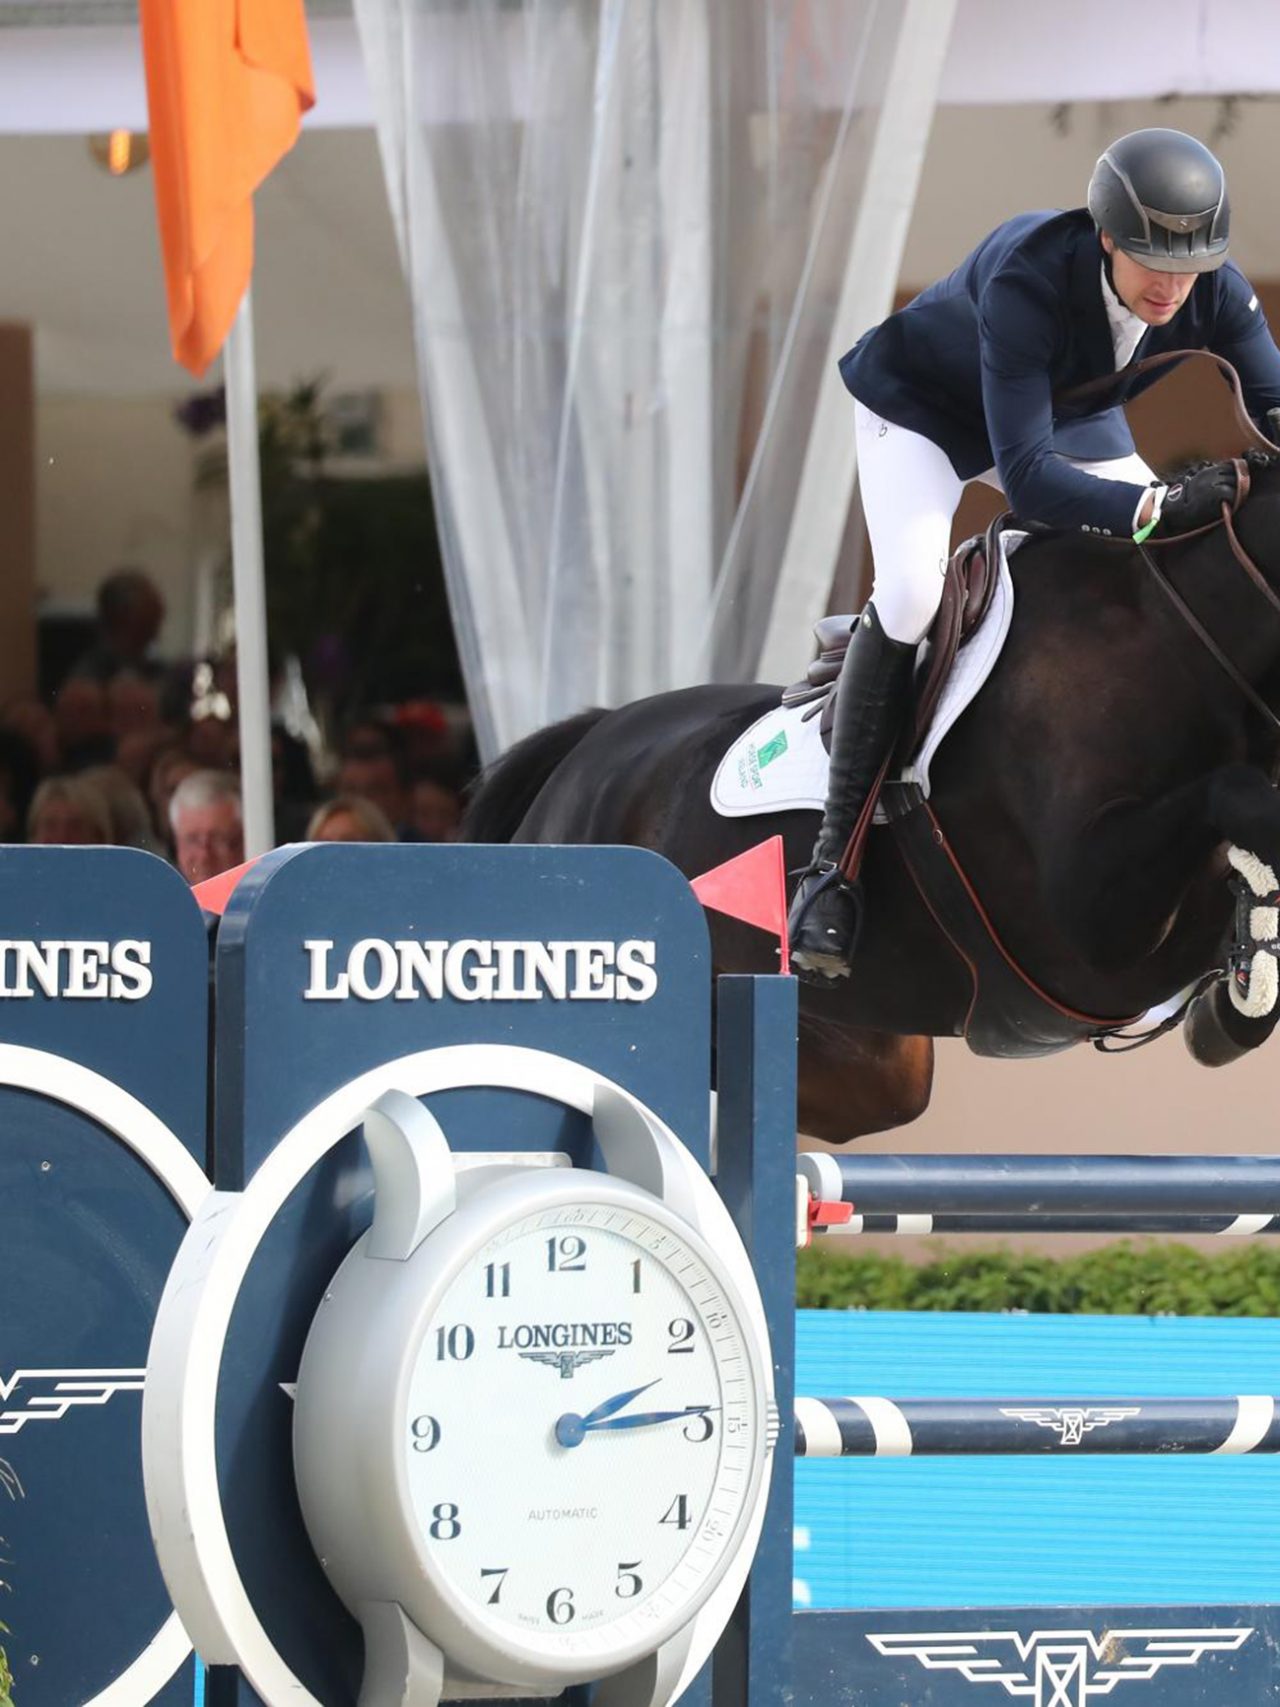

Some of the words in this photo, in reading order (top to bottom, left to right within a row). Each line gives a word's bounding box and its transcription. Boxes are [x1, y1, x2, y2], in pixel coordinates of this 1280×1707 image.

[303, 938, 658, 1001] LONGINES
[546, 1235, 587, 1272] 12
[484, 1261, 511, 1298] 11
[630, 1258, 642, 1294] 1
[435, 1323, 475, 1361] 10
[497, 1322, 633, 1349] LONGINES
[667, 1318, 696, 1354] 2
[411, 1414, 442, 1453] 9
[683, 1405, 714, 1443] 3
[428, 1502, 462, 1541] 8
[527, 1507, 599, 1521] AUTOMATIC
[658, 1493, 693, 1530] 4
[480, 1566, 510, 1605] 7
[614, 1559, 645, 1598] 5
[545, 1586, 576, 1626] 6
